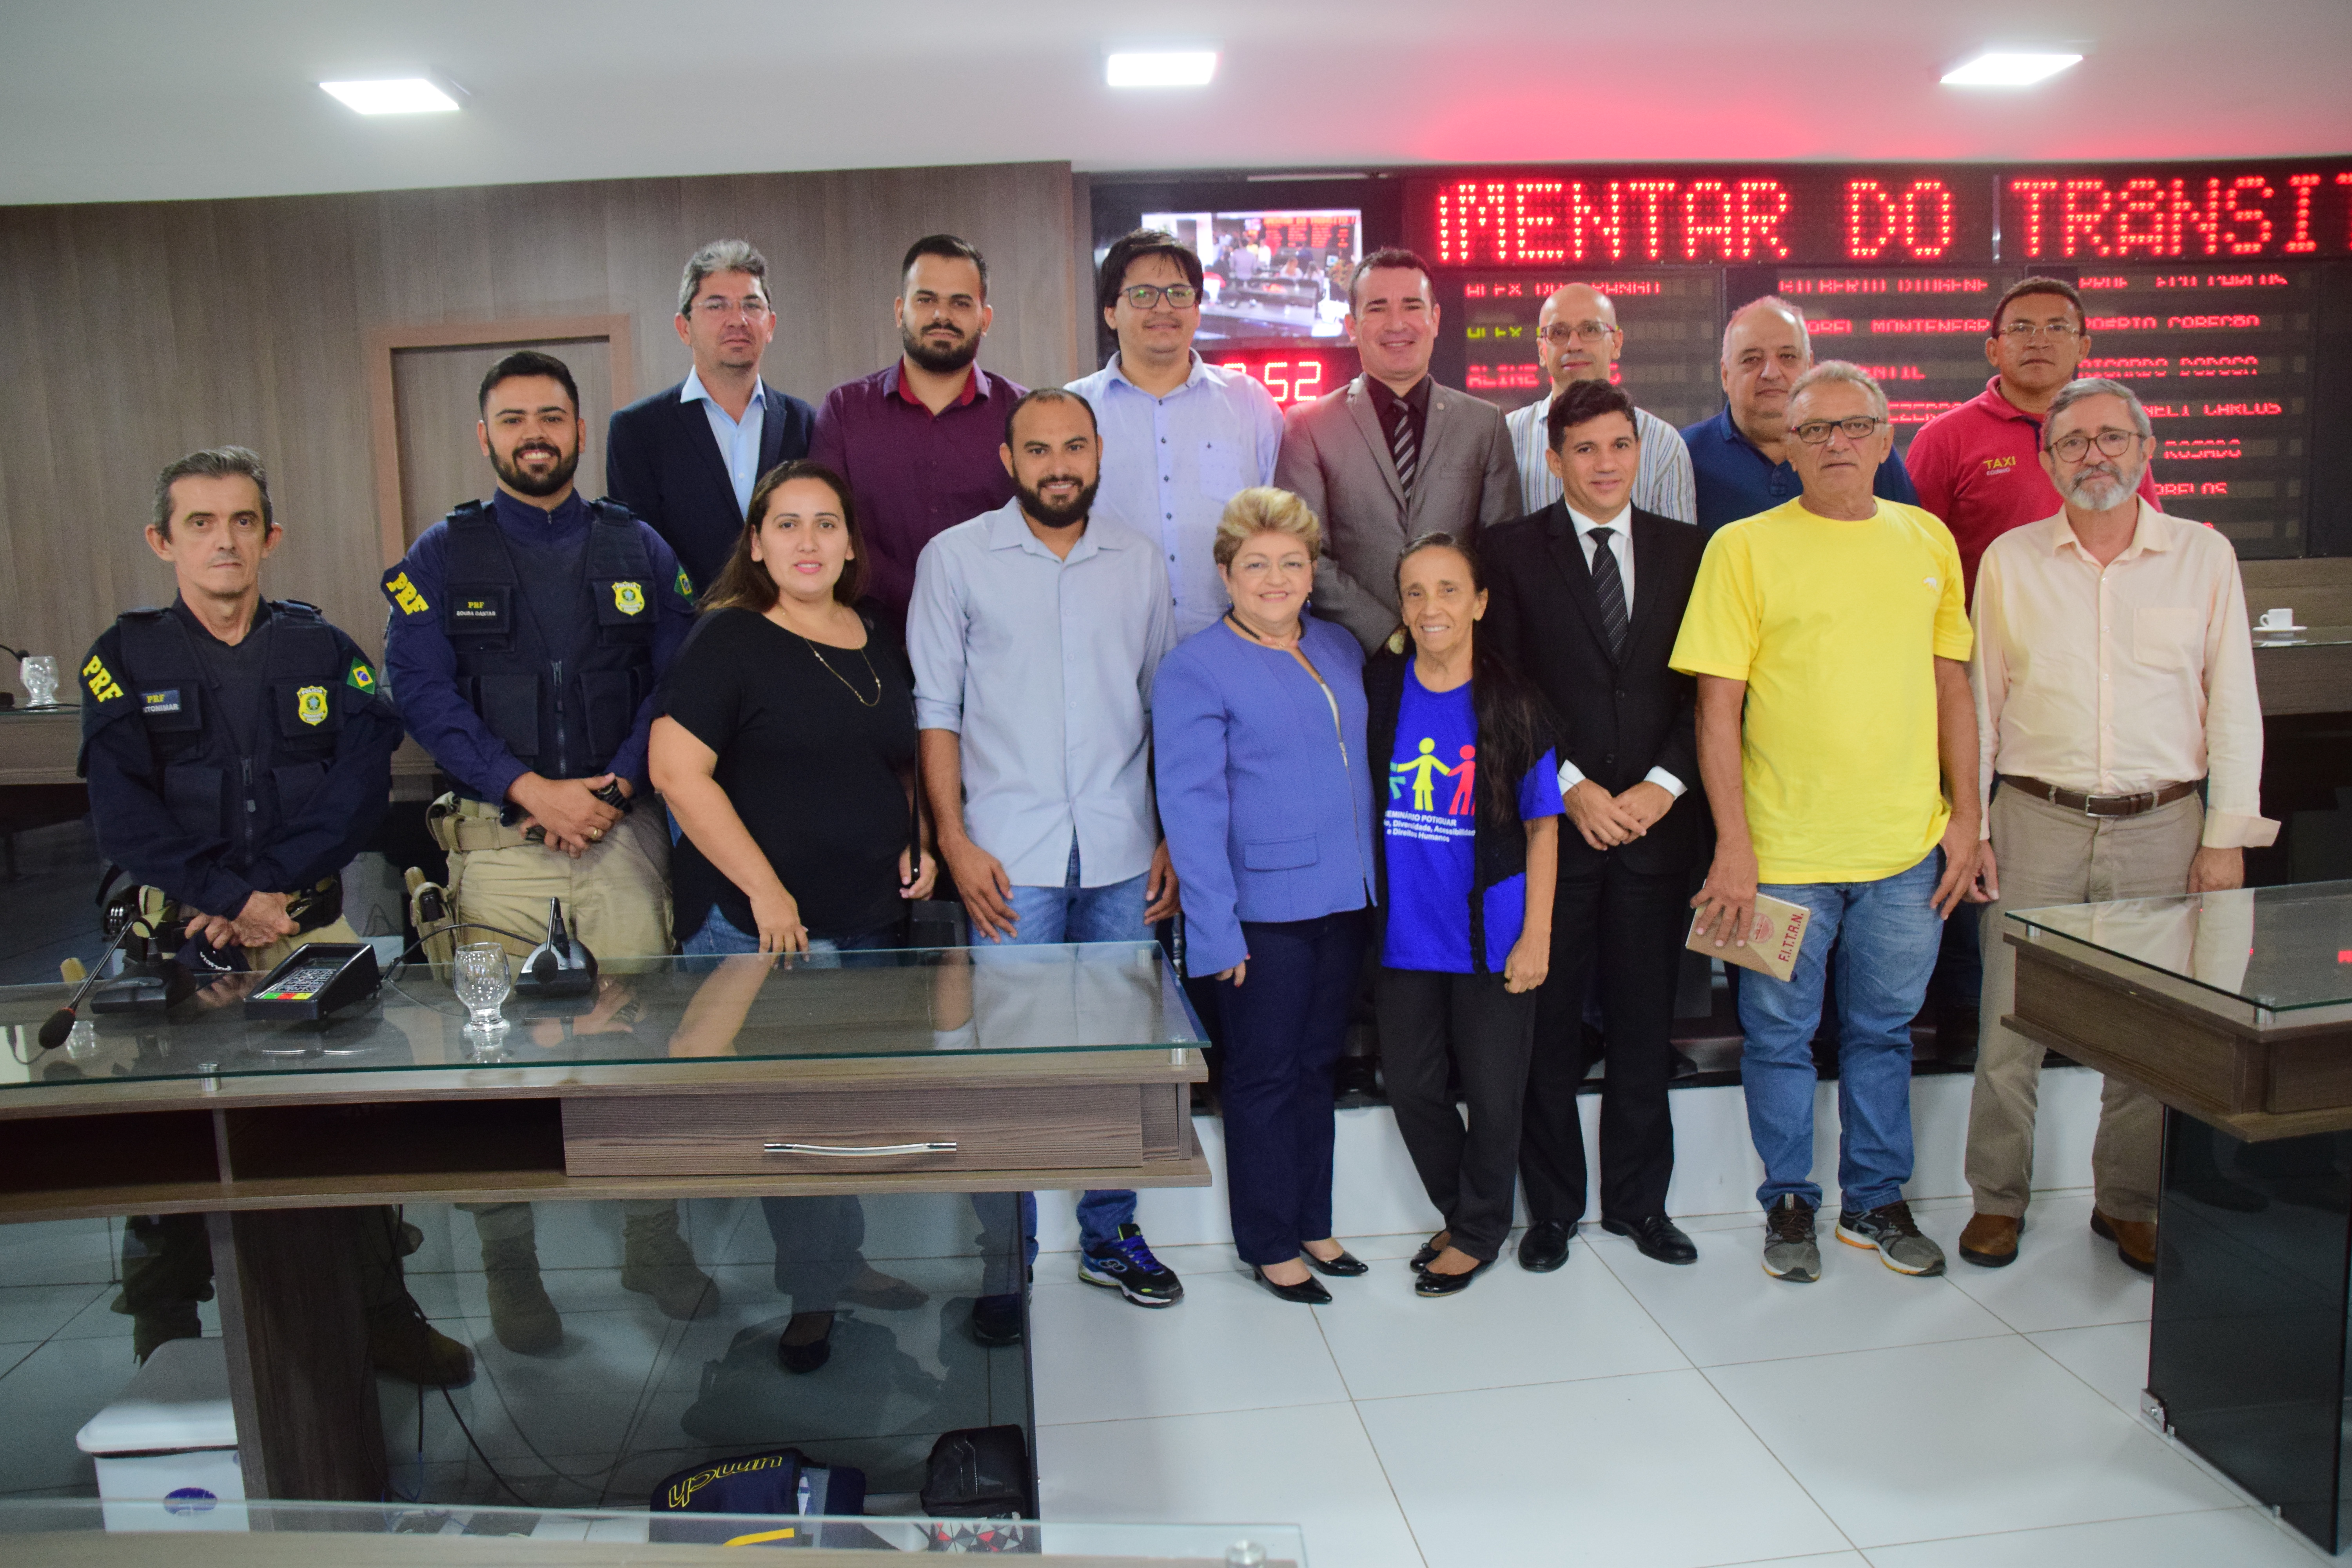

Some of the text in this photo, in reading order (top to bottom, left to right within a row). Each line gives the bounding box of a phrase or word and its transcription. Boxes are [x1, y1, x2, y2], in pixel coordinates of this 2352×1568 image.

[1439, 180, 1791, 262] MENTAR
[1847, 181, 1950, 257] DO
[1983, 456, 2016, 469] TAXI
[386, 572, 429, 615] PRF
[82, 655, 124, 702] PRF
[147, 694, 165, 704] PRF
[143, 704, 179, 713] TONIMAR
[1421, 814, 1457, 827] POTIGUAR
[1393, 828, 1418, 838] Direitos
[1418, 832, 1450, 842] Humanos
